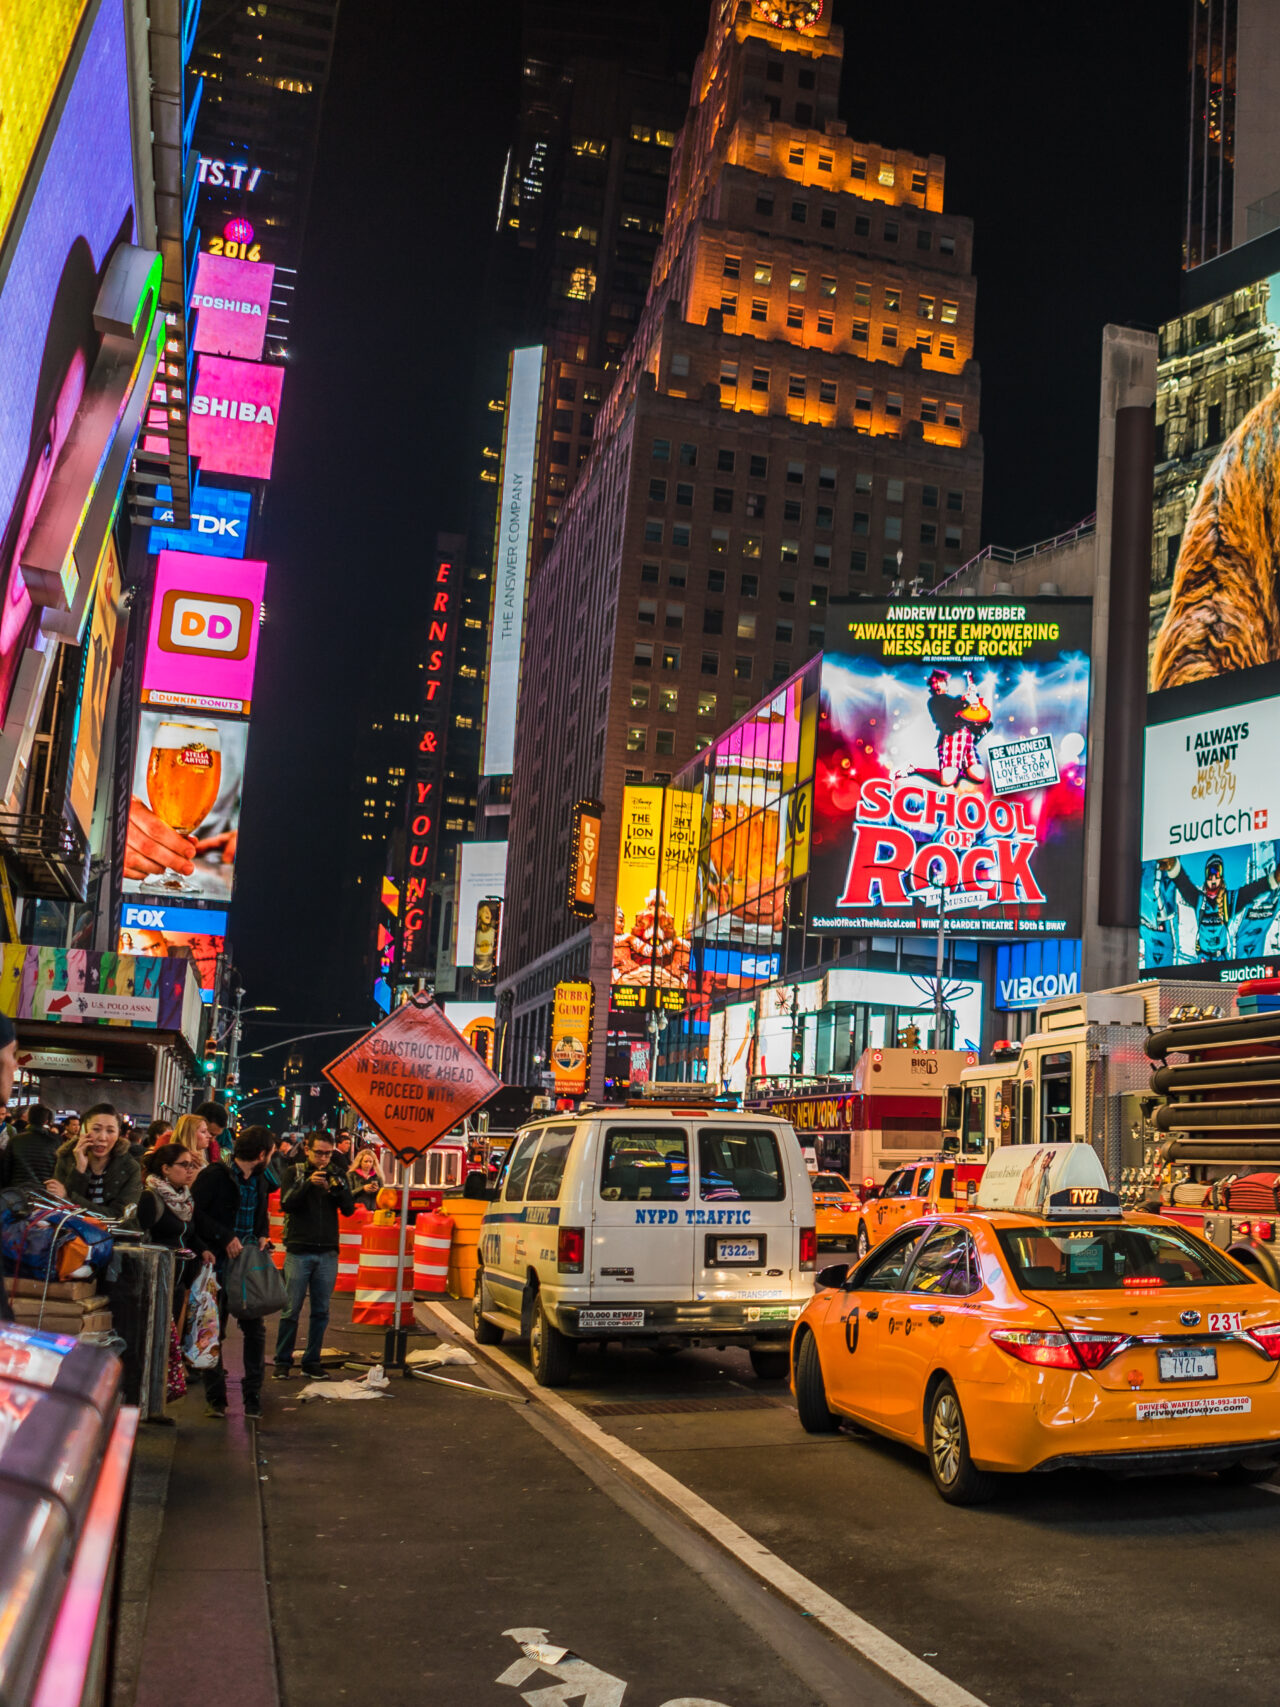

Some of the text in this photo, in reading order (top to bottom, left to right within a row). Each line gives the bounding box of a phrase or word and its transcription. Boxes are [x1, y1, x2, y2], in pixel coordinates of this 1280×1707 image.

[209, 237, 261, 262] 2016
[193, 294, 261, 316] TOSHIBA
[501, 473, 524, 640] THE ANSWER COMPANY
[886, 606, 1026, 621] ANDREW LLOYD WEBBER
[848, 623, 1059, 641] "AWAKENS THE EMPOWERING
[883, 640, 1032, 656] MESSAGE OF ROCK!"
[200, 699, 239, 710] DONUTS
[1186, 722, 1250, 752] I ALWAYS
[403, 562, 451, 931] ERNST & YOUNG
[1005, 738, 1049, 756] WARNED!
[998, 752, 1046, 769] THERE'S A
[1196, 744, 1239, 768] WANT
[996, 760, 1050, 780] LOVE STORY
[1014, 773, 1030, 782] THIS
[1197, 758, 1231, 785] more
[1191, 773, 1237, 807] energy
[856, 777, 1037, 839] SCHOOL
[632, 813, 650, 823] THE
[1169, 808, 1252, 845] swatch
[627, 824, 653, 839] LION
[943, 829, 976, 850] OF
[624, 840, 656, 859] KING
[836, 822, 1048, 908] ROCK
[944, 894, 985, 907] MUSICAL
[126, 908, 165, 928] FOX
[812, 917, 1066, 931] SchoolOfRockTheMusical.com WINTR GARDEN THEATRE 50th & BWAY
[1220, 965, 1267, 983] swatch
[557, 988, 589, 1001] BUBBA
[107, 1002, 129, 1012] POLO
[558, 1003, 586, 1015] GUMP
[373, 1039, 460, 1062] CONSTRUCTION
[357, 1058, 474, 1083] IN BIKE LANE AHEAD
[911, 1059, 926, 1067] BIG
[370, 1081, 454, 1102] PROCEED WITH
[384, 1104, 434, 1122] CAUTION
[797, 1102, 816, 1128] NEW
[816, 1100, 839, 1128] YORK
[1071, 1189, 1099, 1204] 7Y27
[635, 1209, 751, 1225] NYPD TRAFFIC
[720, 1244, 748, 1257] 7322
[1210, 1313, 1241, 1332] 231
[1139, 1401, 1199, 1411] DRIVERS WANTED
